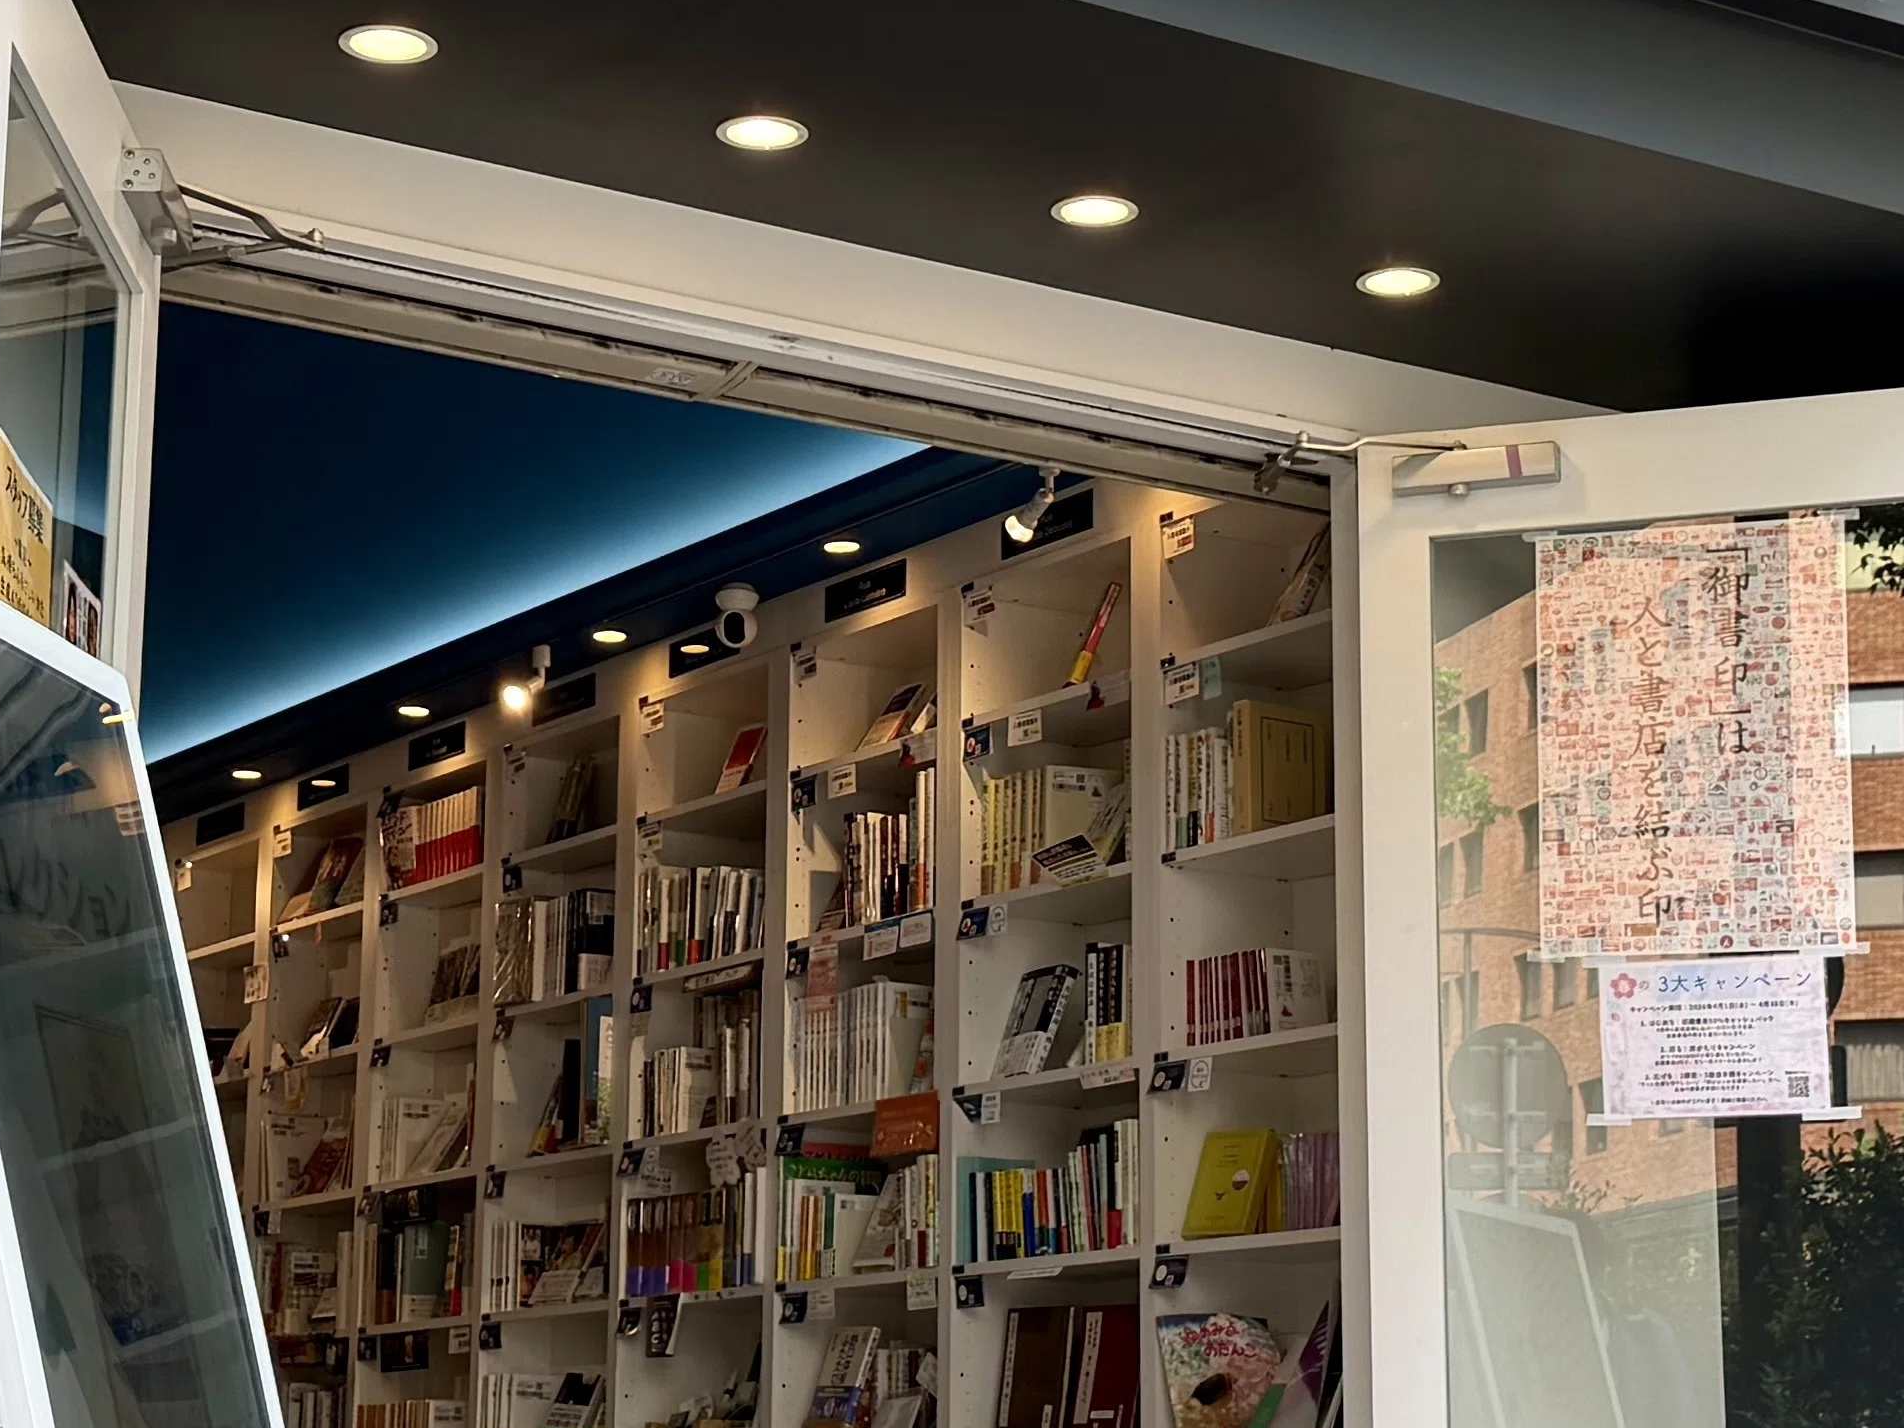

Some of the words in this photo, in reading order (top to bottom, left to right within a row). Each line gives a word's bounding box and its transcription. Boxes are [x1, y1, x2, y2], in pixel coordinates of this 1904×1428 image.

[1705, 546, 1753, 756] 「御書印」は
[1628, 595, 1673, 929] 人と書店を結ぶ印
[1658, 972, 1812, 993] 3大キャンペーン
